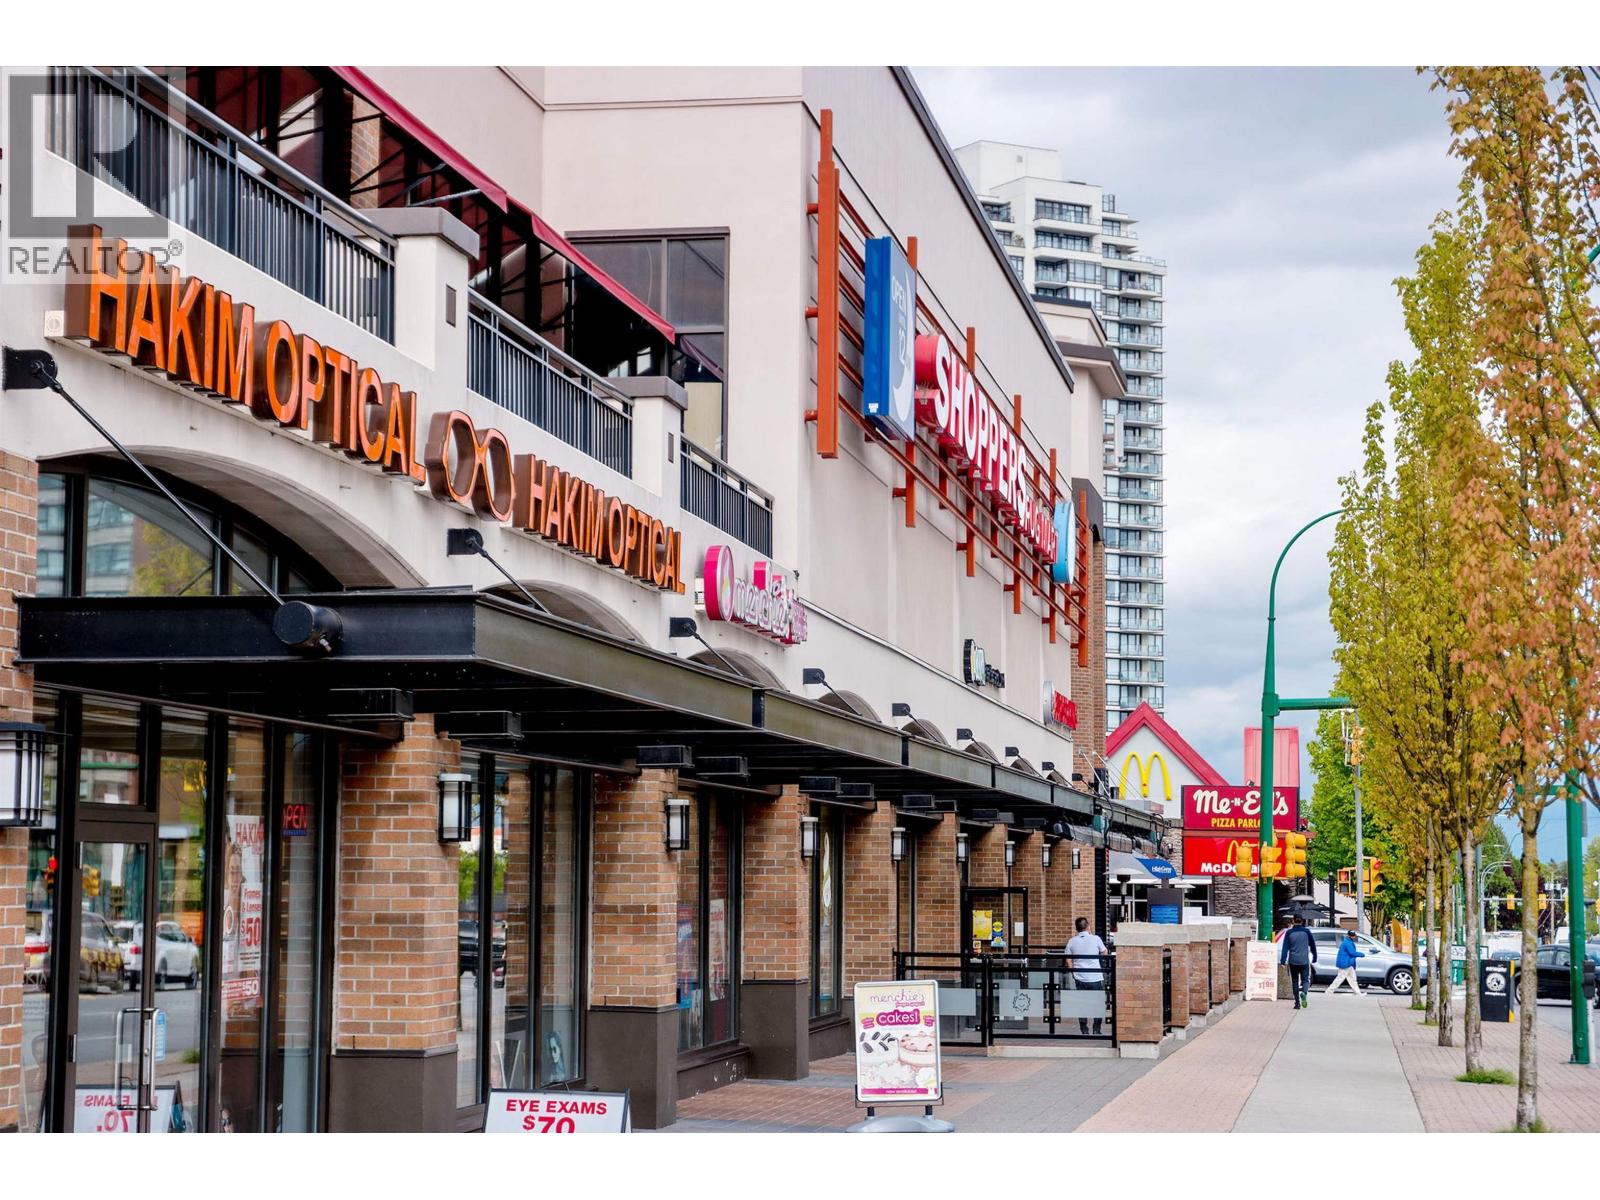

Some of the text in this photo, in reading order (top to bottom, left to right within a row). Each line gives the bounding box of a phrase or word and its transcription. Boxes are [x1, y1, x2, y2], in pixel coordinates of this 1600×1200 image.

[88, 224, 426, 486] HAKIM OPTICAL
[934, 334, 1027, 521] SHOPPERS
[529, 453, 686, 595] HAKIM OPTICAL
[1211, 818, 1235, 828] PIZZA
[878, 1012, 919, 1025] cakes!
[505, 1099, 607, 1115] EYE EXAMS
[522, 1114, 576, 1133] $70
